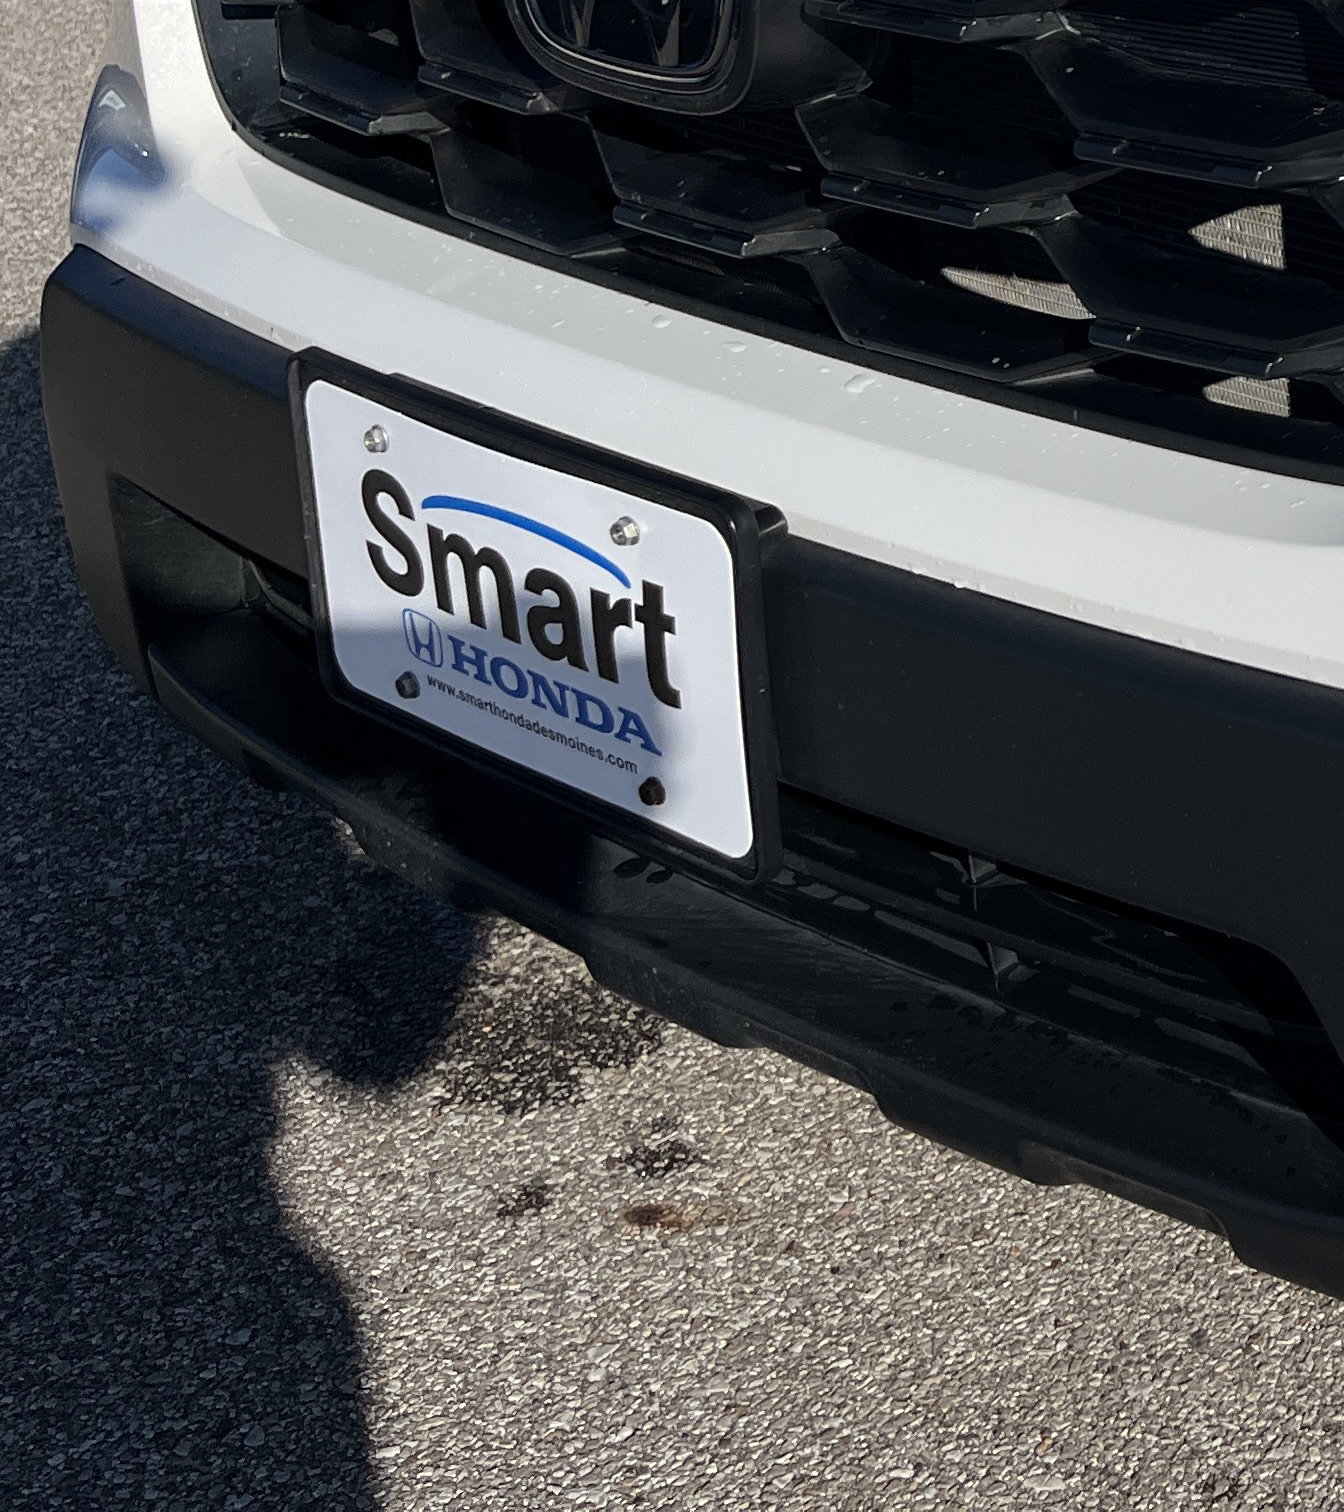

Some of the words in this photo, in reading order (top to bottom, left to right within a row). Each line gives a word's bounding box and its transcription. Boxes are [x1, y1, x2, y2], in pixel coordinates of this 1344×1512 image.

[361, 468, 683, 710] Smart
[427, 674, 639, 774] www.smarthondadesmoines.com
[447, 634, 662, 756] HONDA
